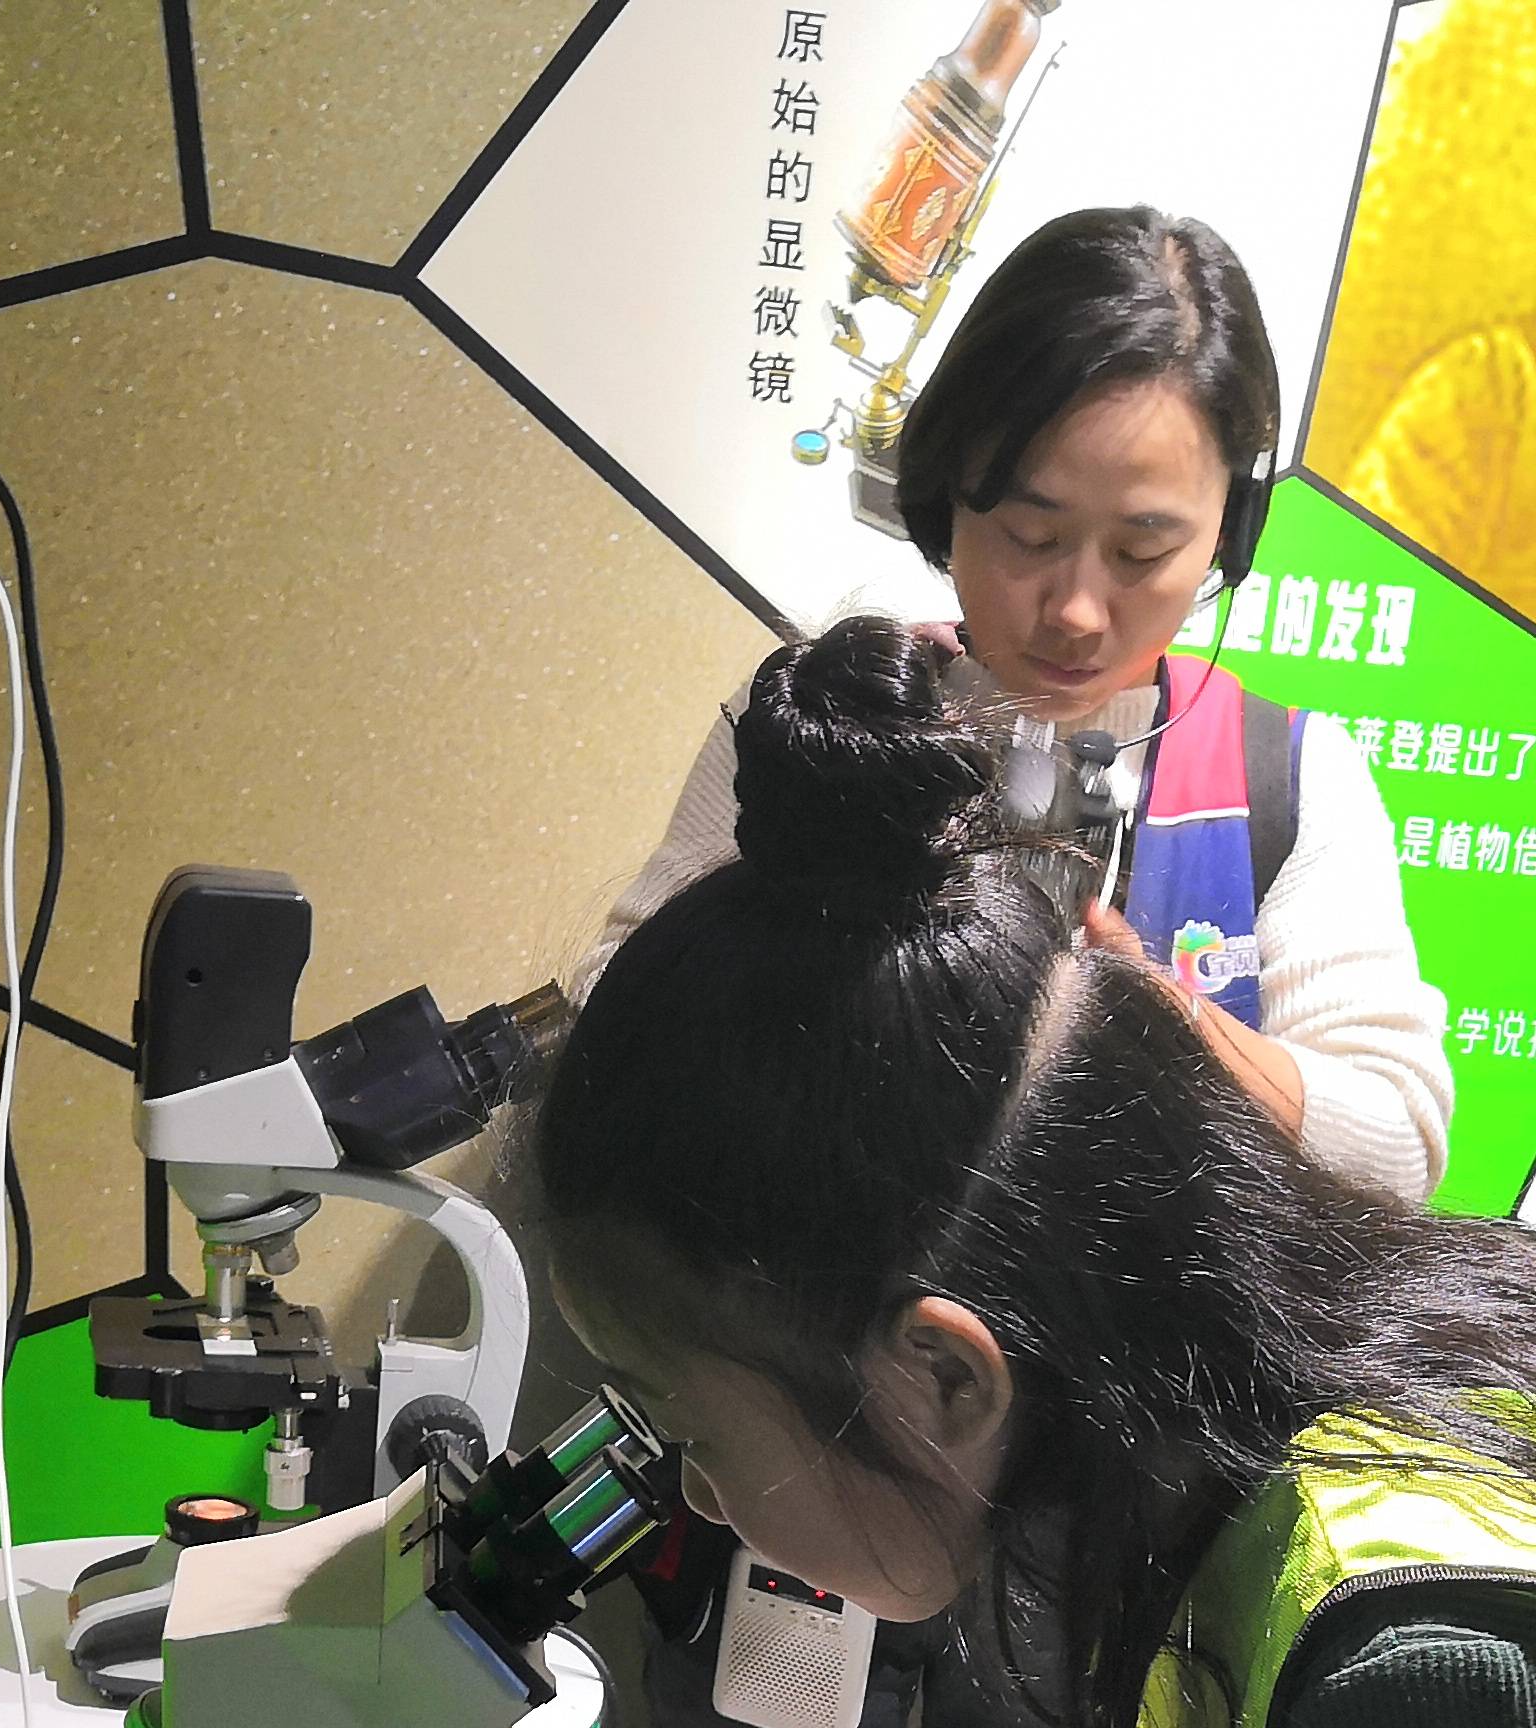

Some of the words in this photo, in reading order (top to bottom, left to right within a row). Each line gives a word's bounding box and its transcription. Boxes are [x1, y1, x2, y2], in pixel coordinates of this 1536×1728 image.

[748, 10, 826, 405] 原始的显微镜
